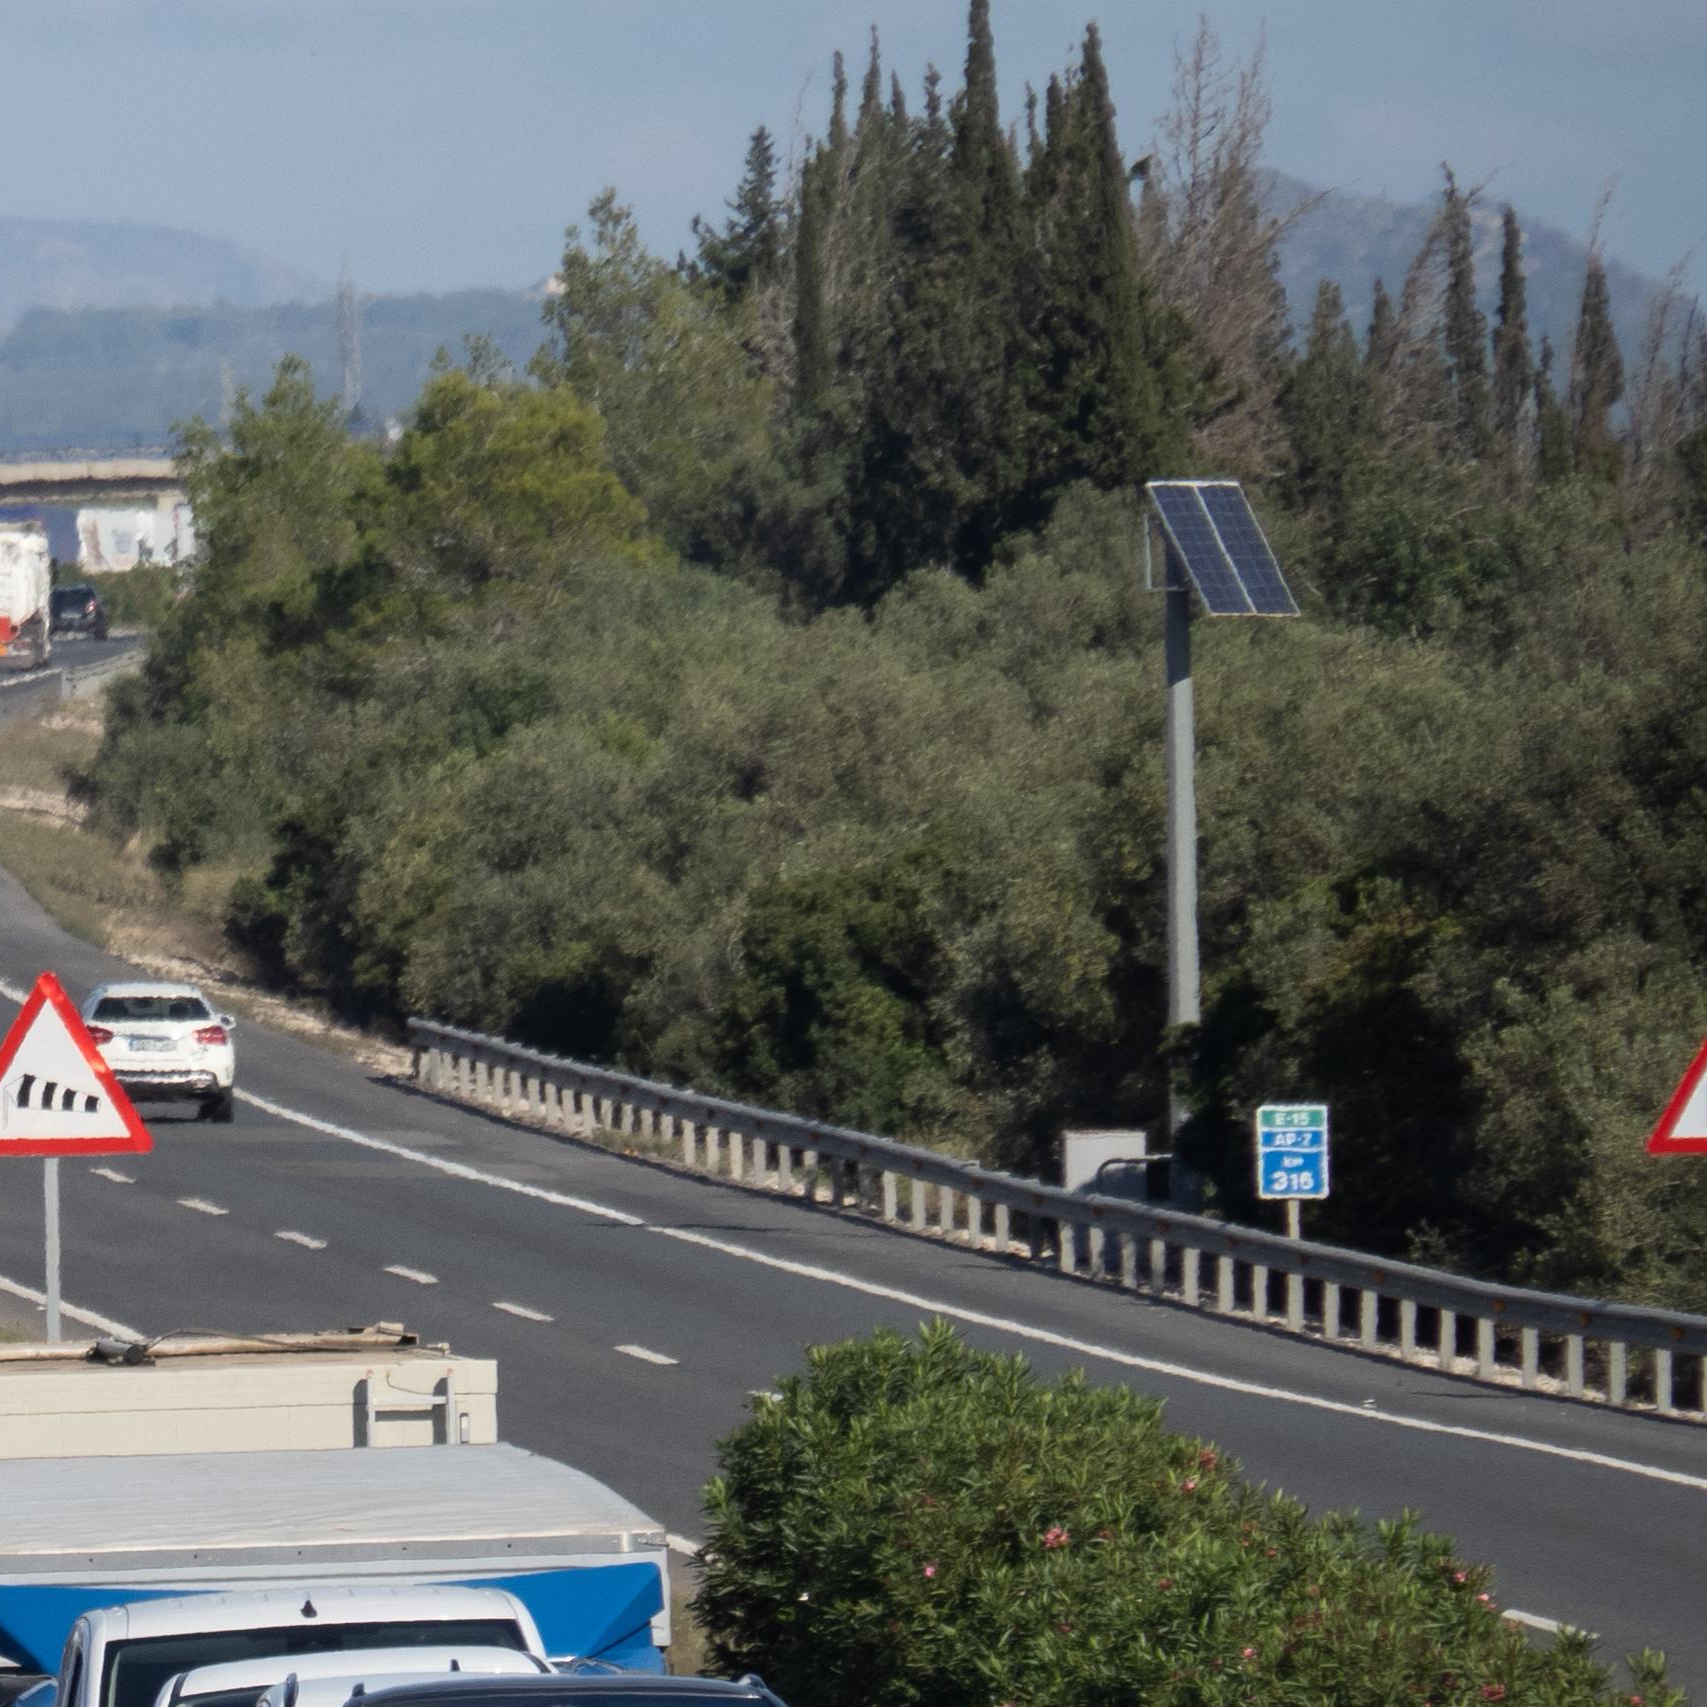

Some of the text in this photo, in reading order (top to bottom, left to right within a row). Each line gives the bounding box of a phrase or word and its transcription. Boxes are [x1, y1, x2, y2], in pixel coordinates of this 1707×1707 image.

[1274, 1111, 1310, 1127] E-15
[1274, 1132, 1313, 1147] AP-7
[1272, 1170, 1315, 1191] 316
